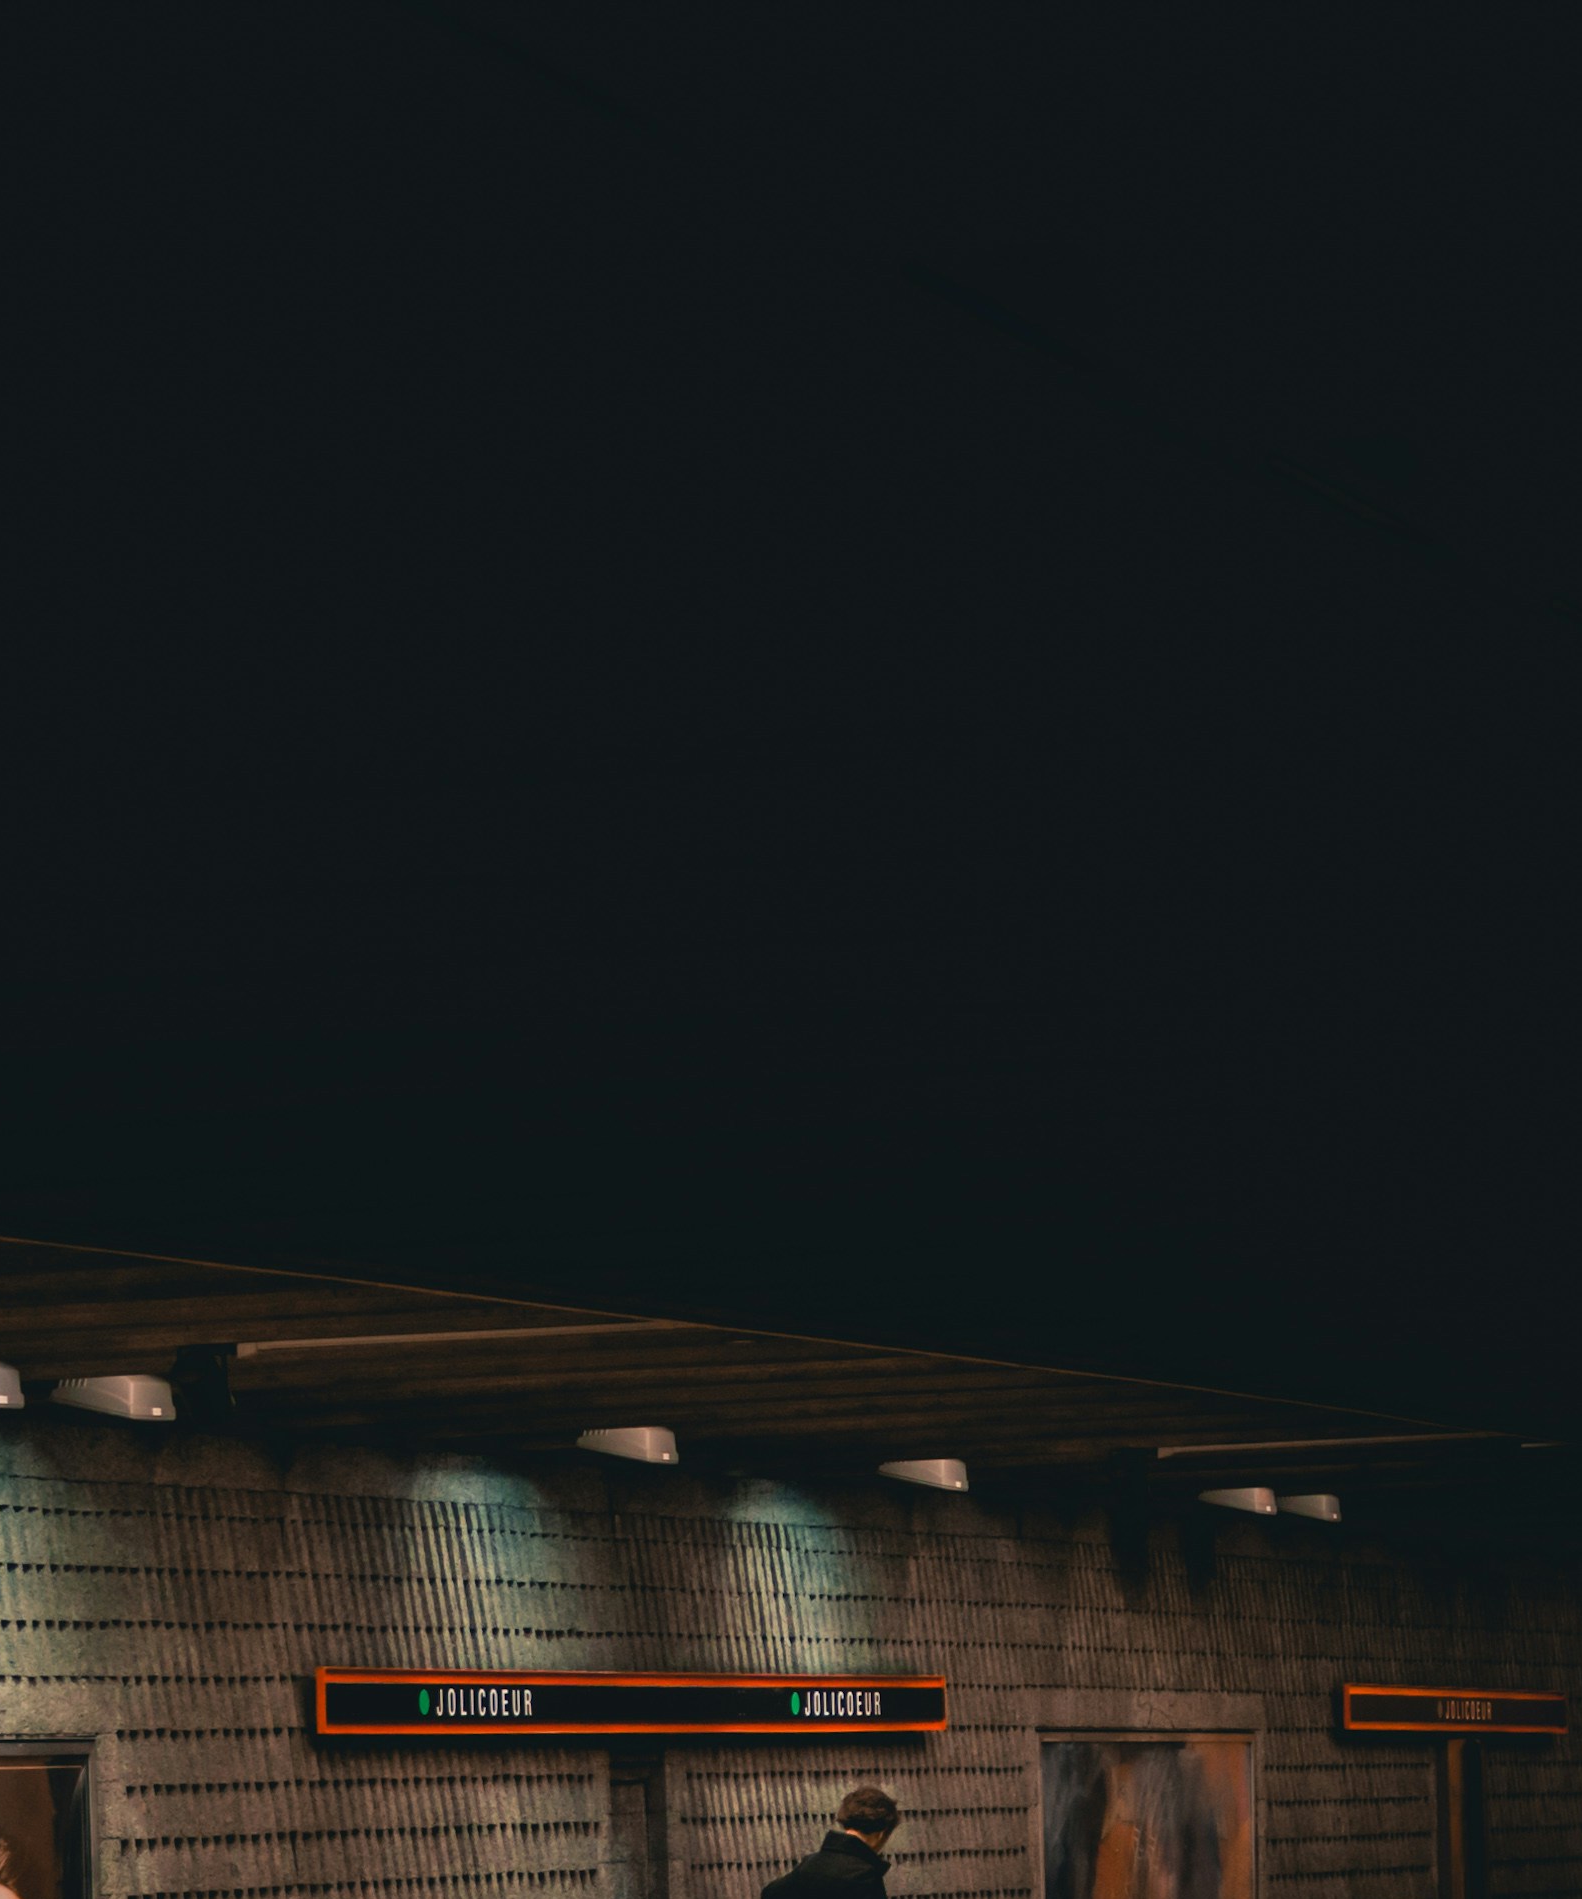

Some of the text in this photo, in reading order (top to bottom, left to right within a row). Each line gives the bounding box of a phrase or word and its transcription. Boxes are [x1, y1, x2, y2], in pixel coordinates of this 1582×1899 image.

[435, 1688, 533, 1717] JOLICOEUR
[804, 1691, 882, 1717] JOLICOEUR
[1445, 1701, 1492, 1720] JOLICOEUR
